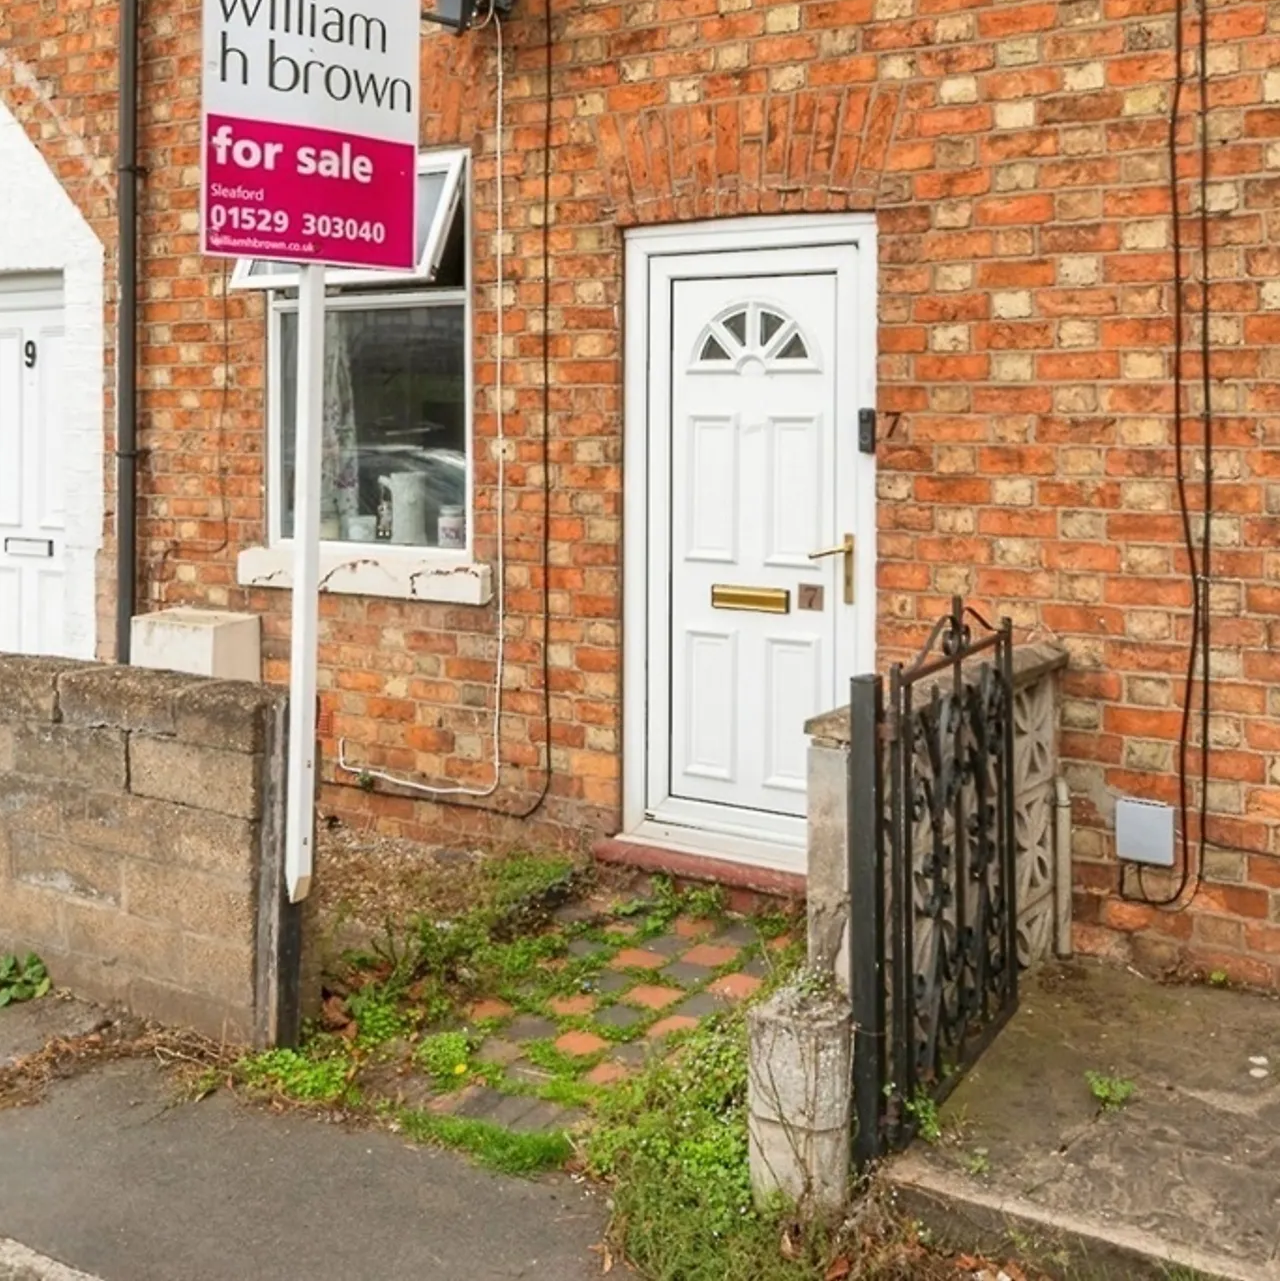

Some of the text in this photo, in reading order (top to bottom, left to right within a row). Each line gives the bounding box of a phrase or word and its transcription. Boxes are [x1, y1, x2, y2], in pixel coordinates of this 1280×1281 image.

[220, 30, 411, 113] h brown
[212, 125, 374, 184] for sale
[210, 183, 265, 202] Sleaford
[210, 204, 386, 244] 01529 303040
[24, 339, 37, 370] 9
[884, 410, 902, 439] 7
[804, 586, 819, 609] 7
